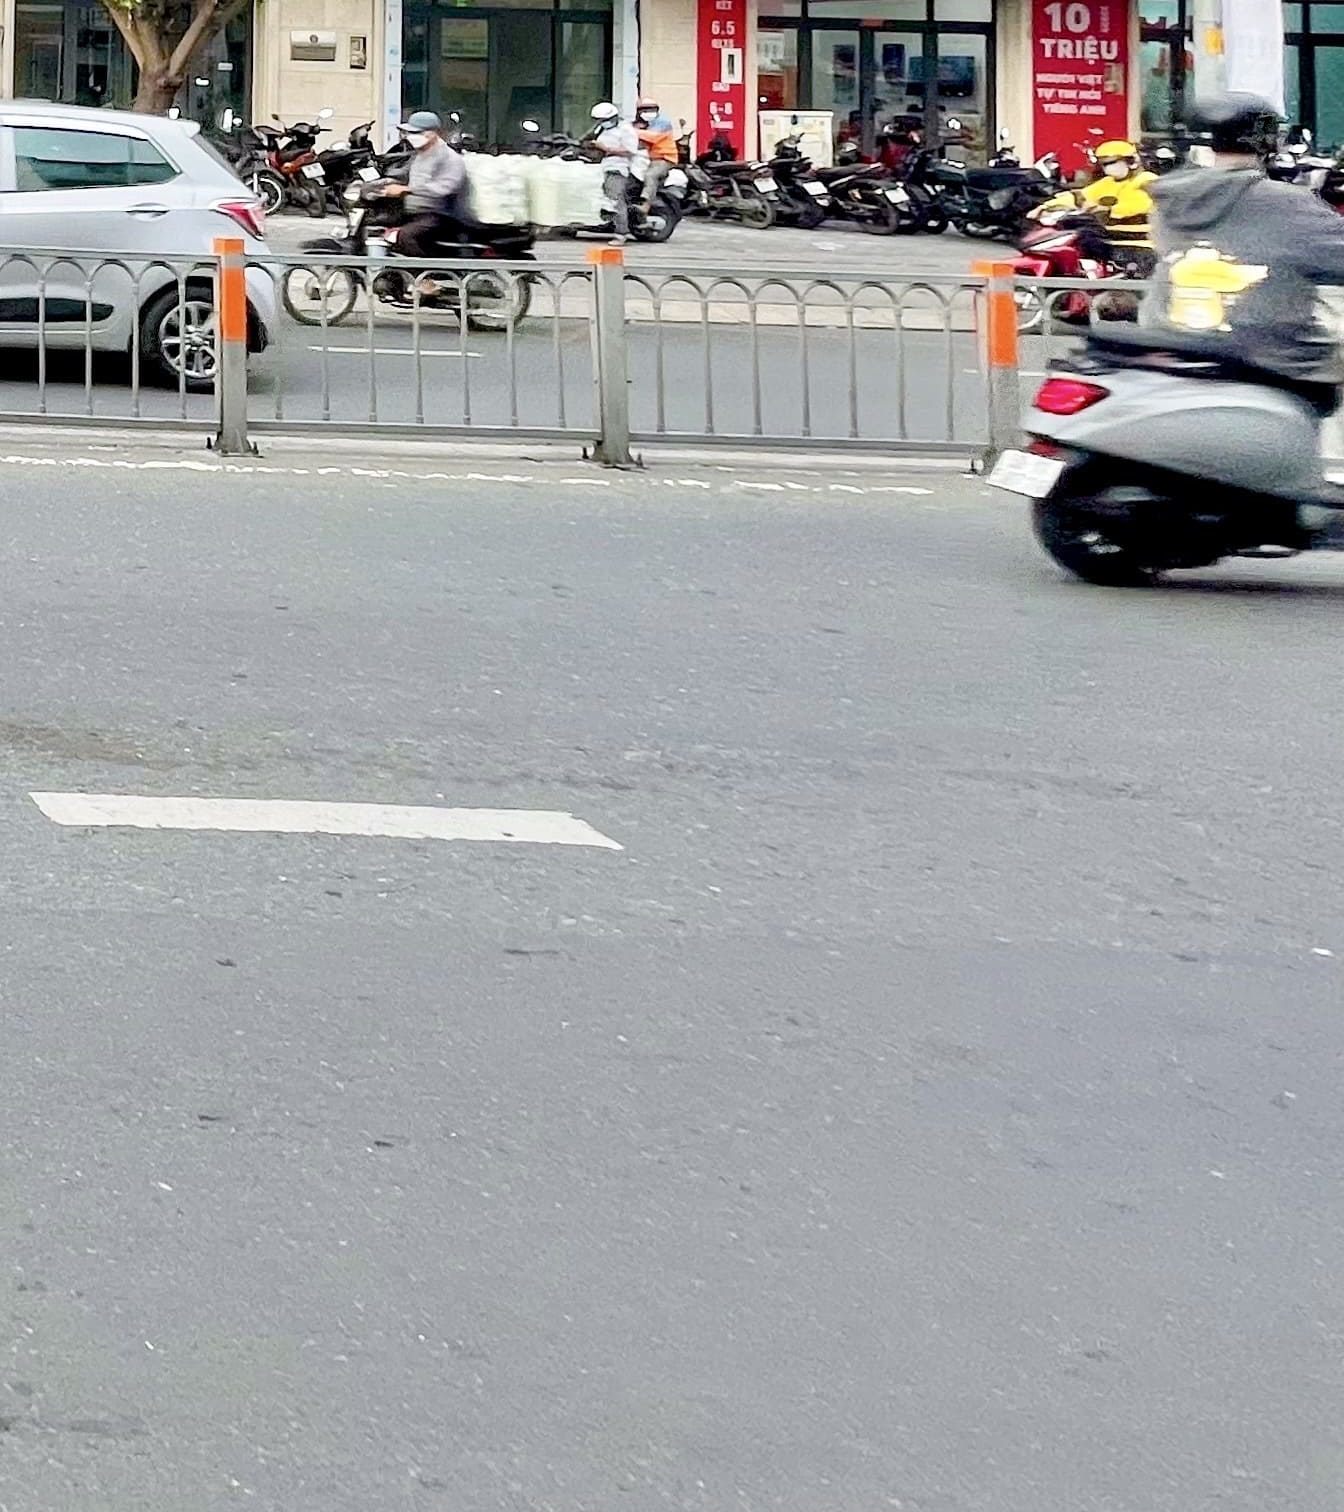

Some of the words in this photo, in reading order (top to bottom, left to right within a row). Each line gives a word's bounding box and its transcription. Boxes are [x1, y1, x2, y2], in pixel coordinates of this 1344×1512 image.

[711, 20, 736, 36] 6.5
[1044, 2, 1091, 33] 10
[1039, 35, 1119, 66] TRIỆU
